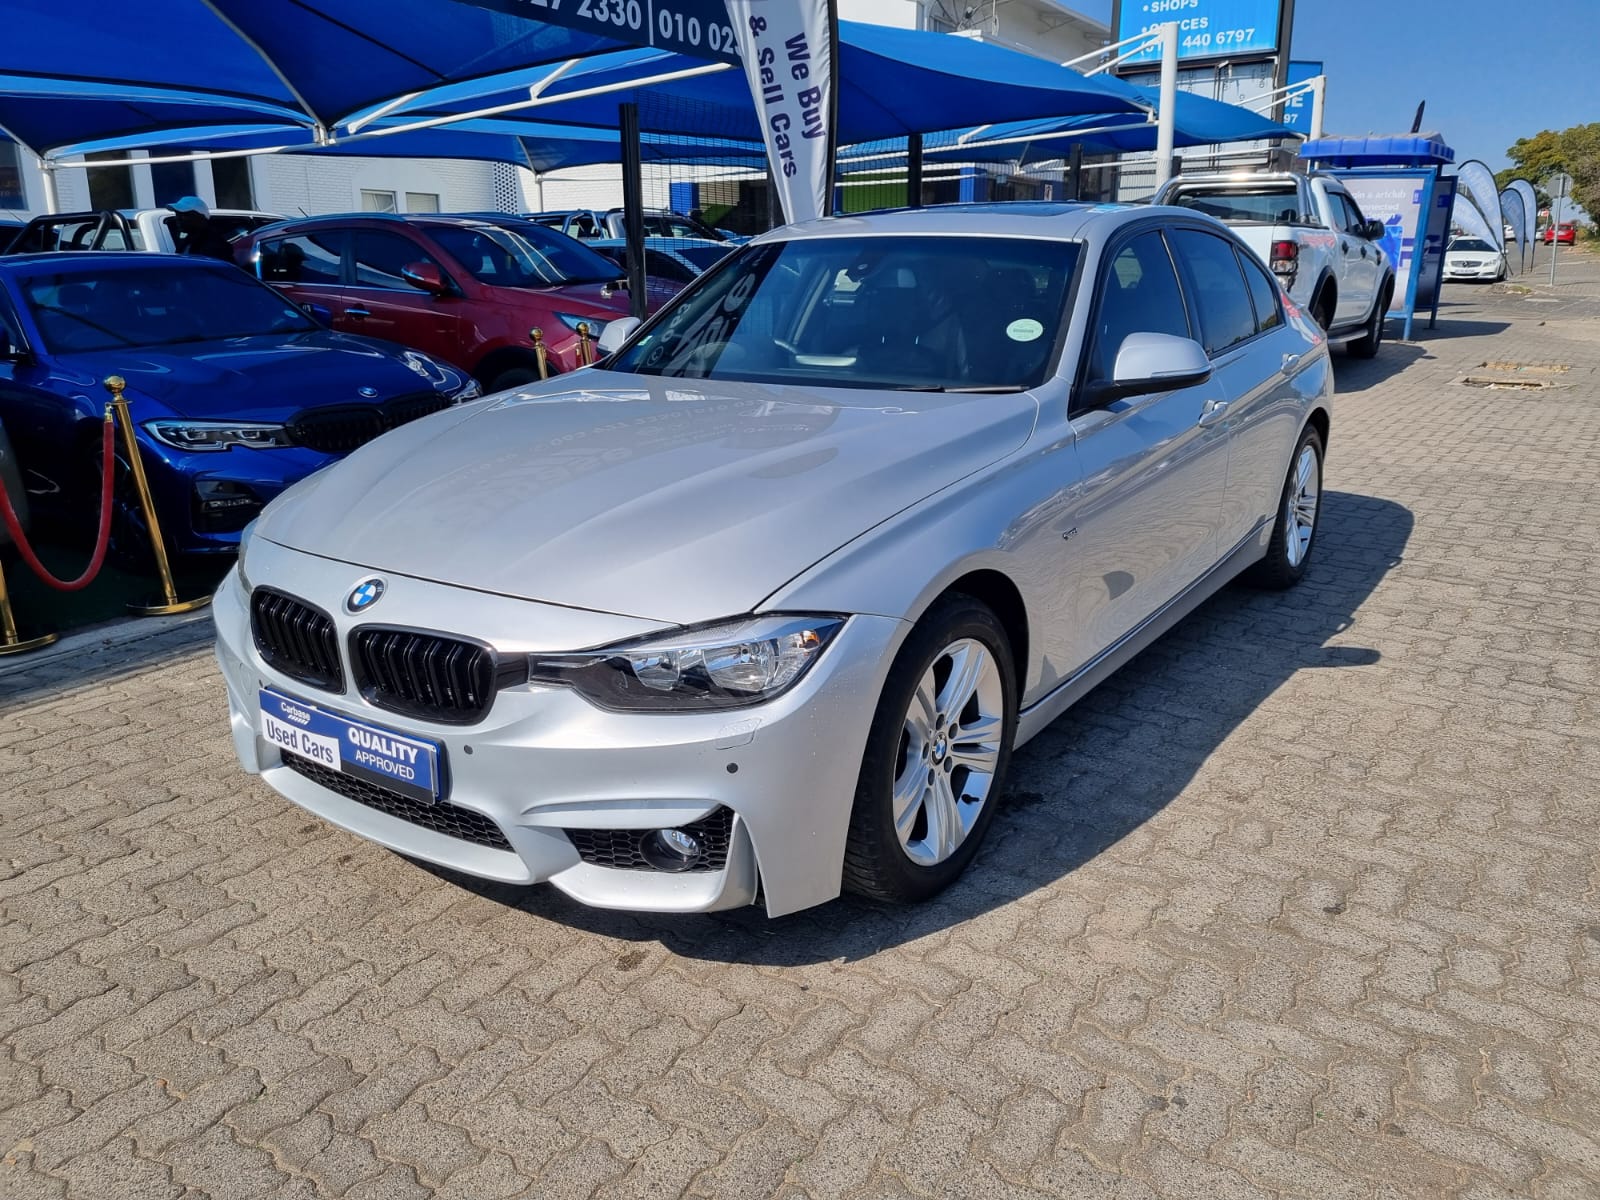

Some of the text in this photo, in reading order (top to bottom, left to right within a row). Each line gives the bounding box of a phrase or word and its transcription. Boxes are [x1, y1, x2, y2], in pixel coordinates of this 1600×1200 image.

[1151, 0, 1198, 12] SHOPS
[577, 0, 742, 57] 2330 010 02
[1183, 33, 1211, 47] 440
[1216, 28, 1255, 44] 6797
[749, 15, 797, 178] & Sell Cars
[785, 32, 826, 140] We Buy
[281, 702, 311, 721] Carbase
[266, 718, 334, 764] Used Cars
[348, 727, 418, 764] QUALITY
[355, 750, 415, 780] APPROVED
